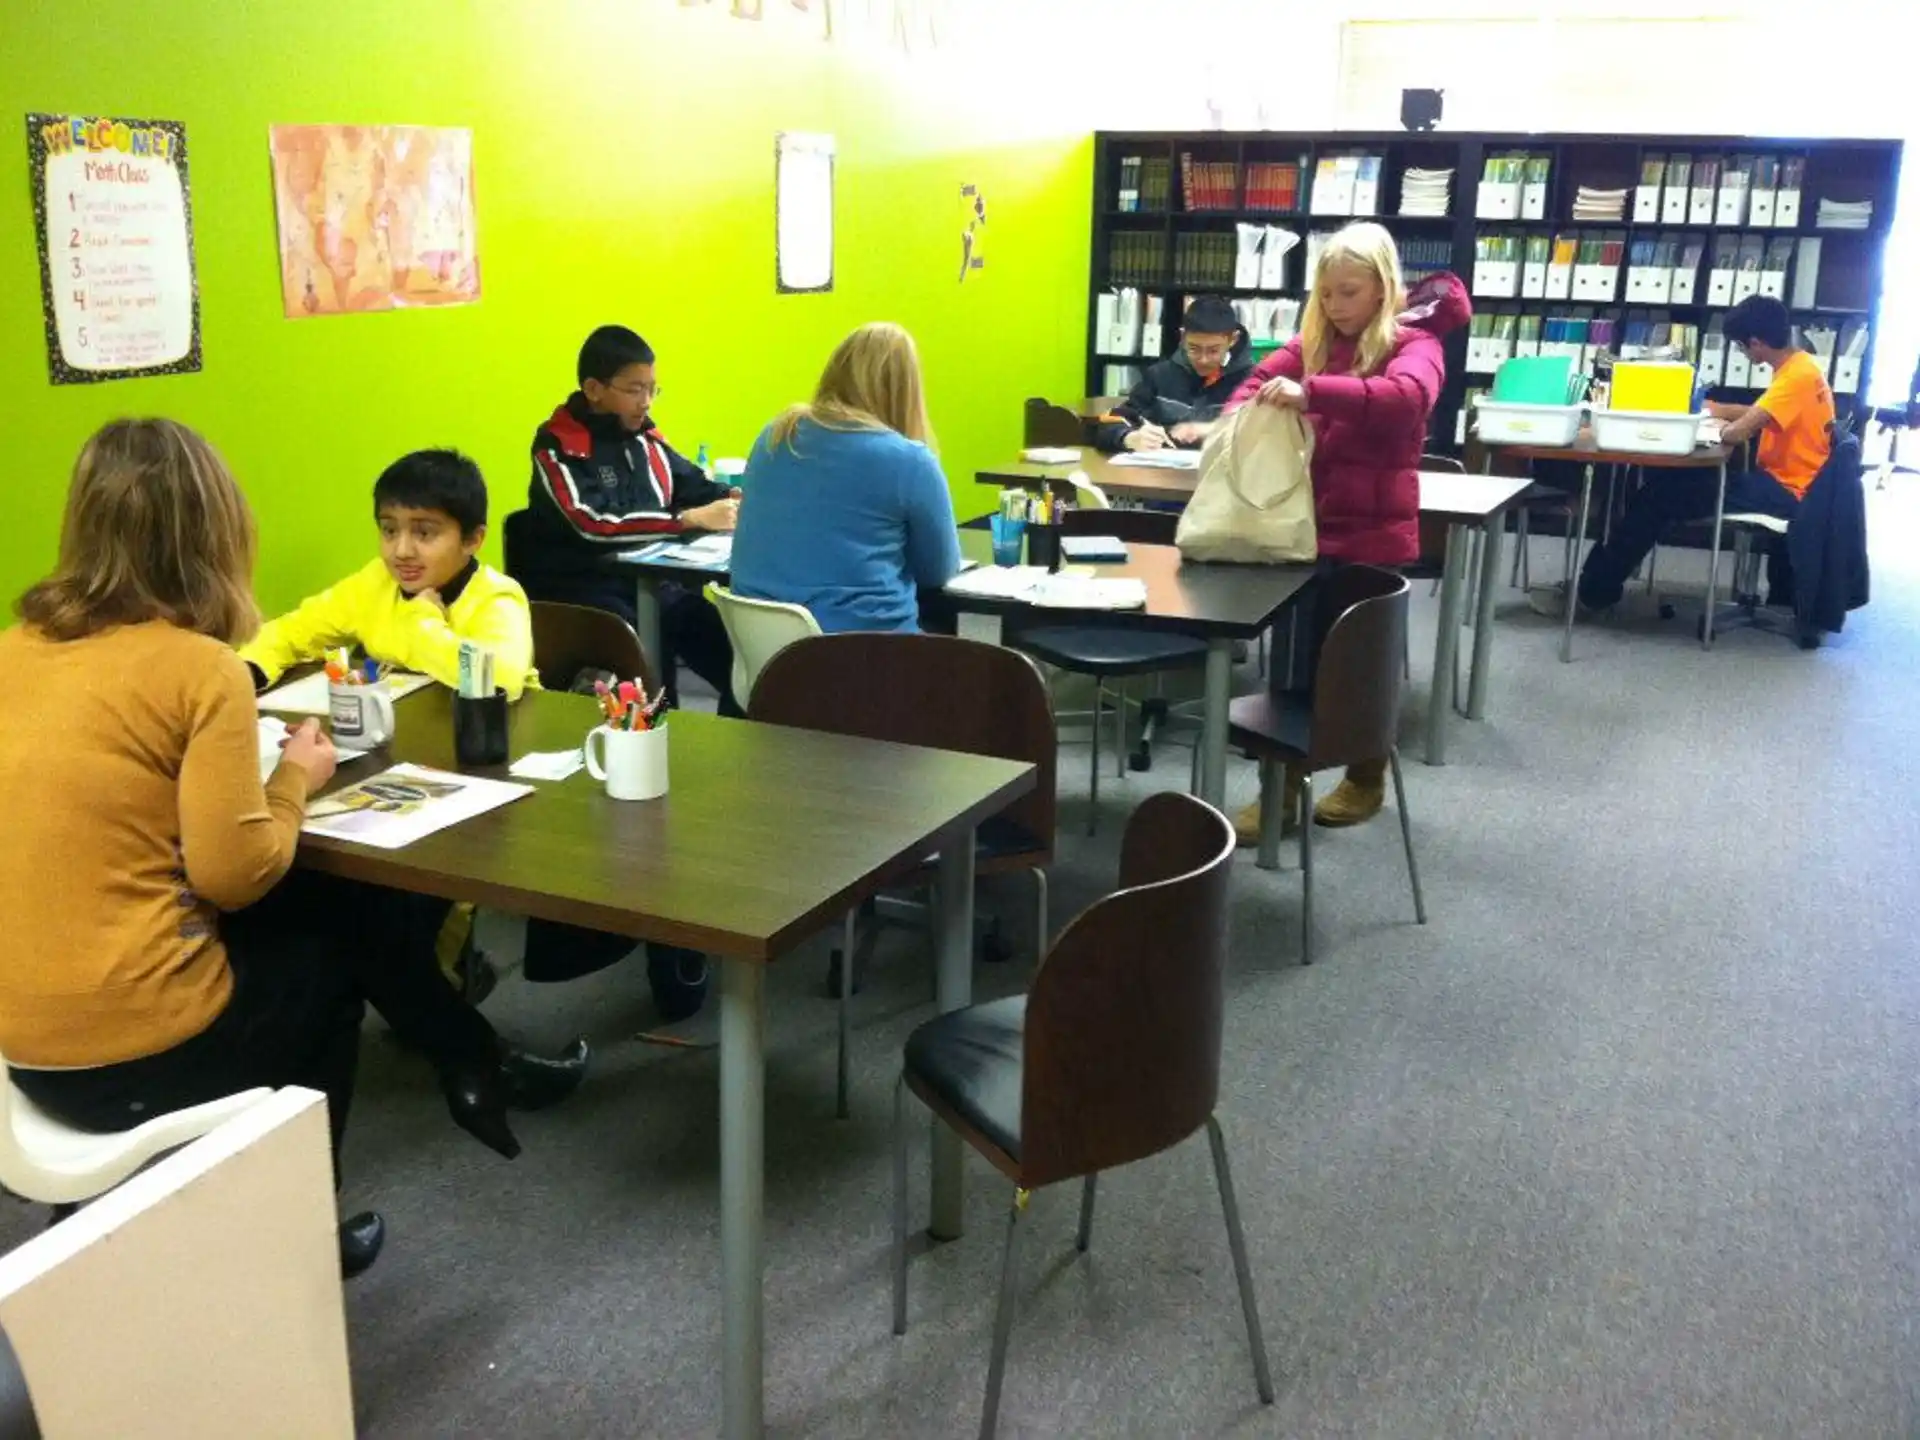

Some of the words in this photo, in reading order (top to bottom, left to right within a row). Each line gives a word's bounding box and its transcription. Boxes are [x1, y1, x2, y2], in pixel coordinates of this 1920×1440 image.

[42, 117, 177, 165] WELCOME!
[84, 160, 117, 182] Math
[119, 161, 149, 184] Class
